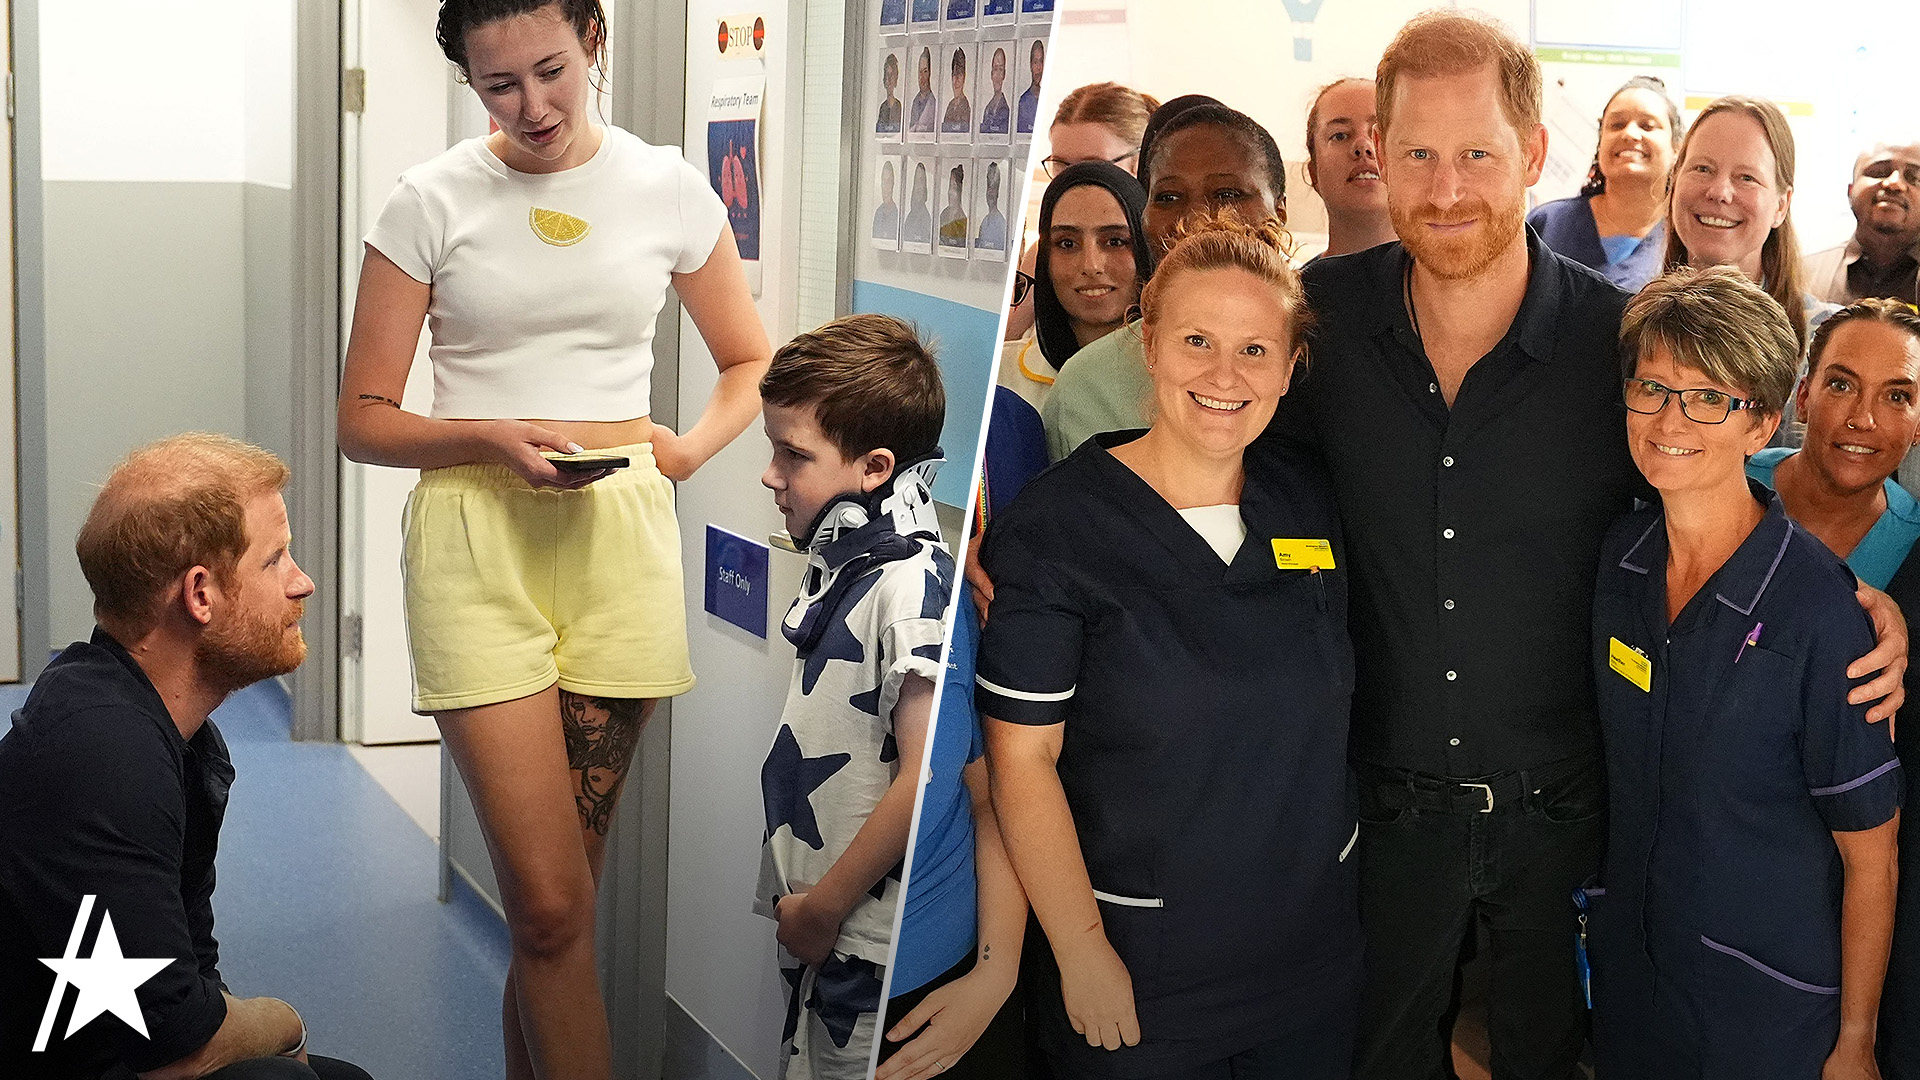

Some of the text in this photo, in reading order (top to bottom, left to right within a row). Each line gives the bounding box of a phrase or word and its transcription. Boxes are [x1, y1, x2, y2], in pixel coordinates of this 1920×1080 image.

[729, 26, 753, 47] STOP
[743, 93, 759, 105] Team
[719, 566, 751, 597] Staff Only
